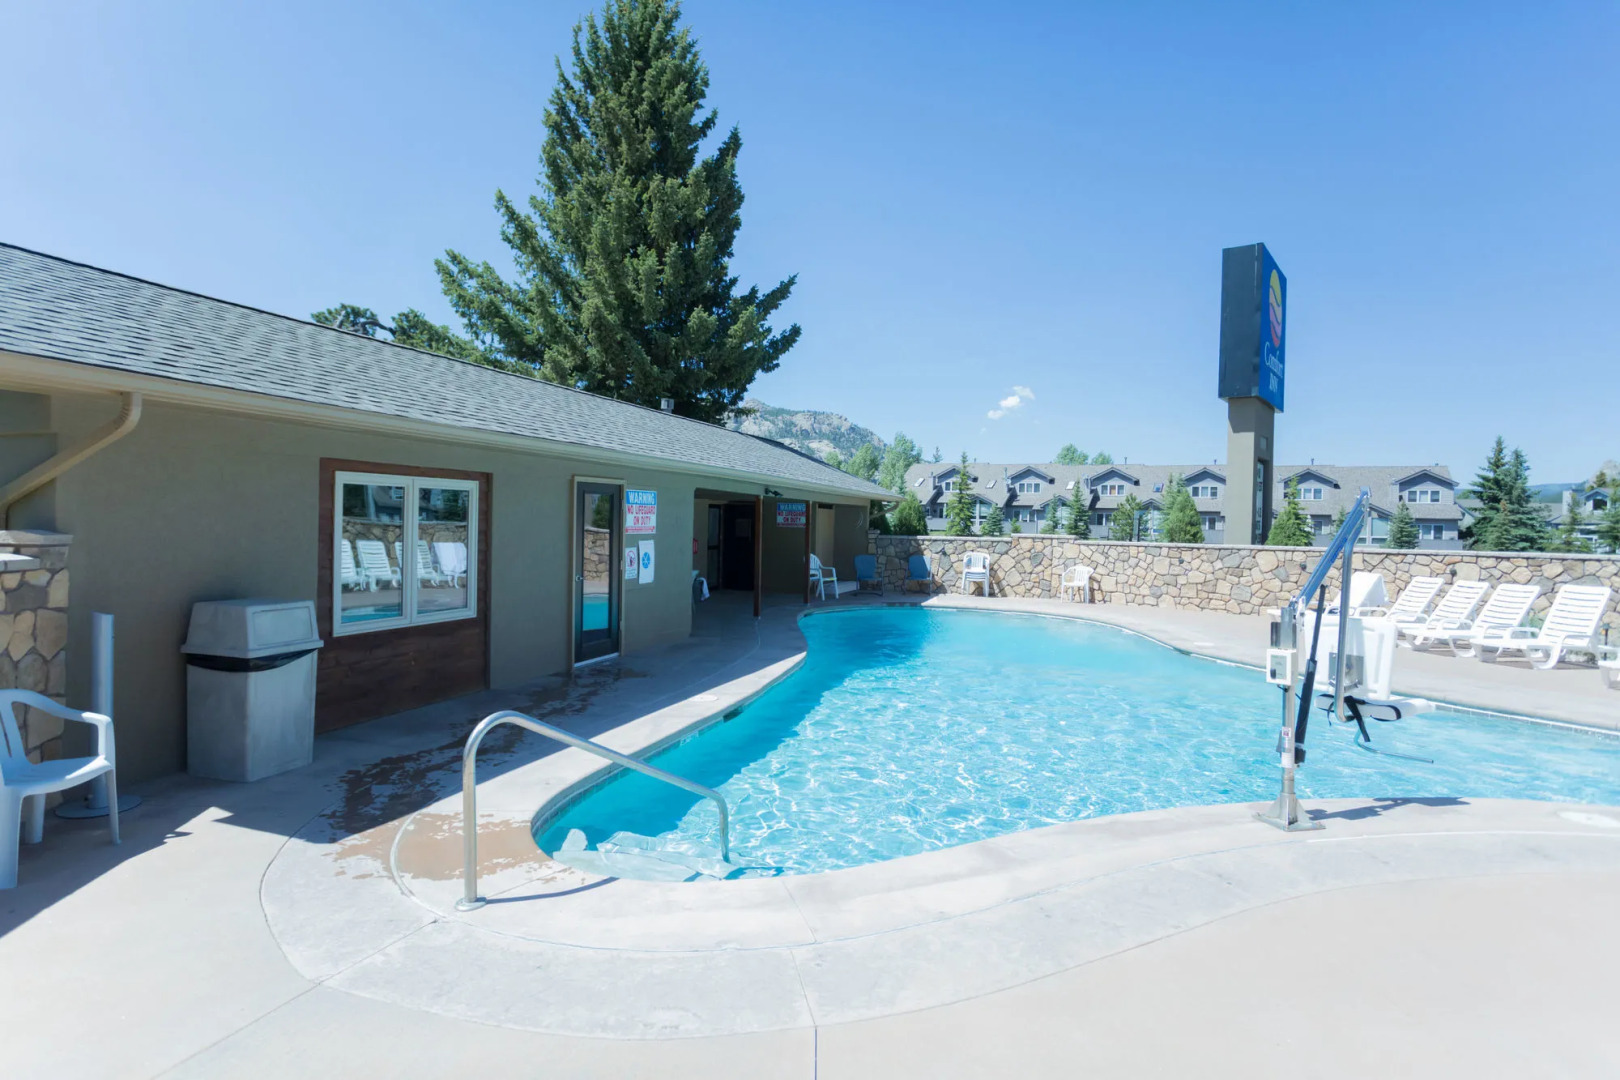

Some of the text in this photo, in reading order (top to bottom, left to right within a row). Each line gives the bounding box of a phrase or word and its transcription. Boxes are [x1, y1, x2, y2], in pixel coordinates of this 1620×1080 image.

[628, 491, 655, 504] WARNING
[627, 505, 655, 515] NO LIFEGUARD
[779, 503, 806, 511] WARNING
[633, 516, 650, 525] ON DUTY
